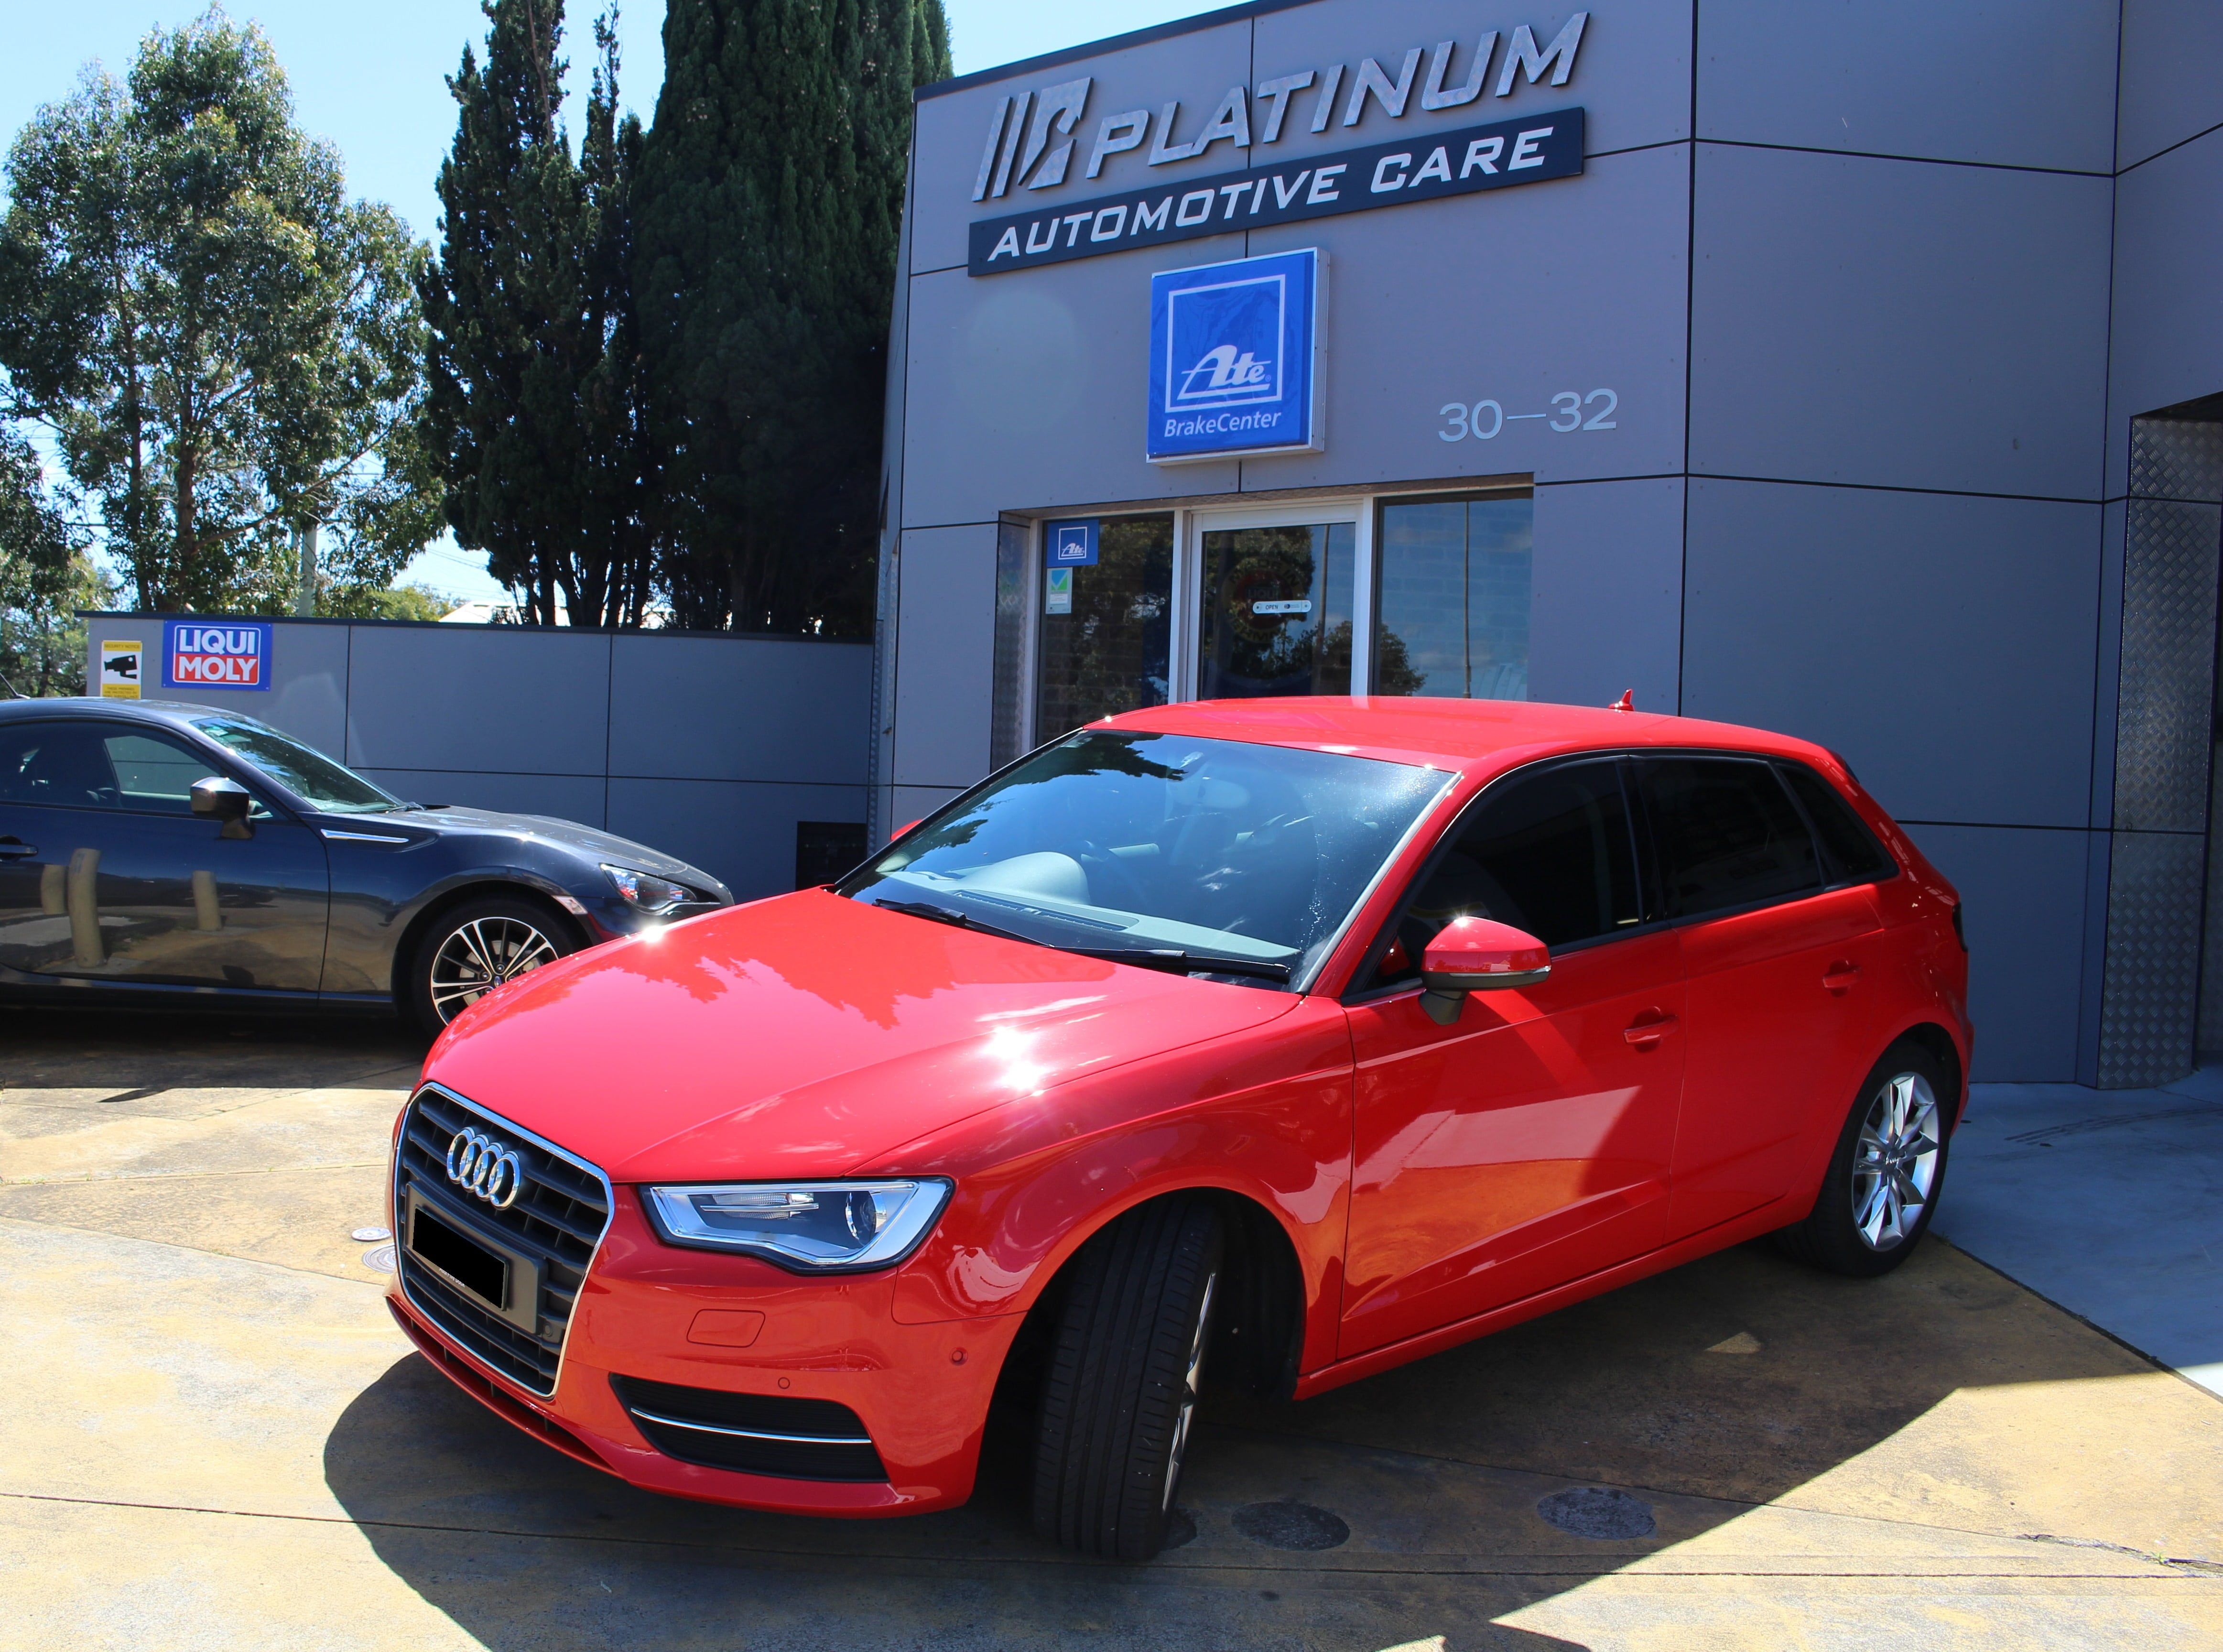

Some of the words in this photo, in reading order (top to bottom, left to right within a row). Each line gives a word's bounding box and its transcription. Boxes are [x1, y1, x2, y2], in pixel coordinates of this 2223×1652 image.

[1086, 12, 1590, 179] PLATINUM
[987, 164, 1346, 261] AUTOMOTIVE
[1369, 126, 1555, 194] CARE
[1177, 344, 1271, 401] Ate
[1164, 411, 1282, 438] BrakeCenter
[179, 629, 255, 655] LIQUI
[179, 656, 256, 681] MOLY
